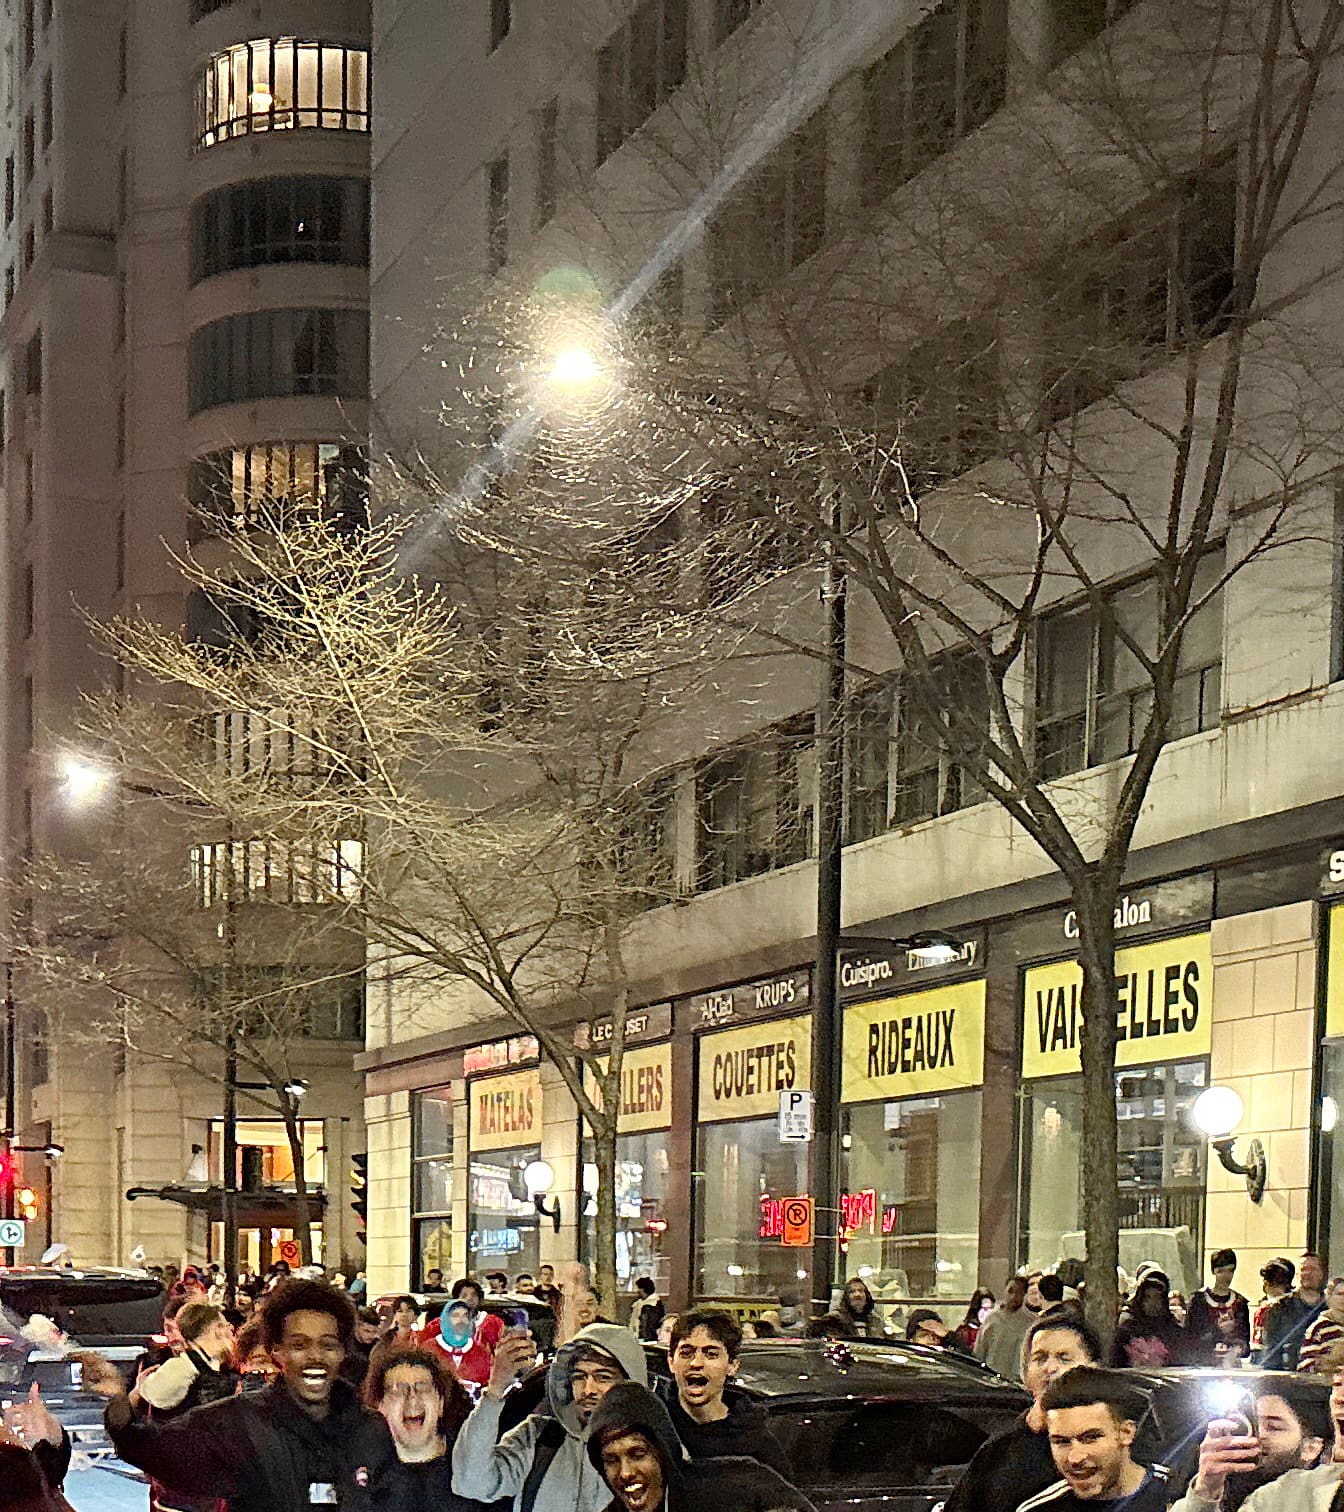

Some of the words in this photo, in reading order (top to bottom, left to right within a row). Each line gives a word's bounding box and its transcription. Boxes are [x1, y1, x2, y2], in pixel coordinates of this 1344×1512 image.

[1064, 895, 1152, 938] Calon
[756, 979, 795, 1009] KRUPS
[1036, 960, 1200, 1054] VAIELLES
[867, 1008, 956, 1079] RIDEAUX
[713, 1040, 796, 1100] COUETTES
[479, 1087, 533, 1135] MATELAS
[790, 1093, 802, 1111] P
